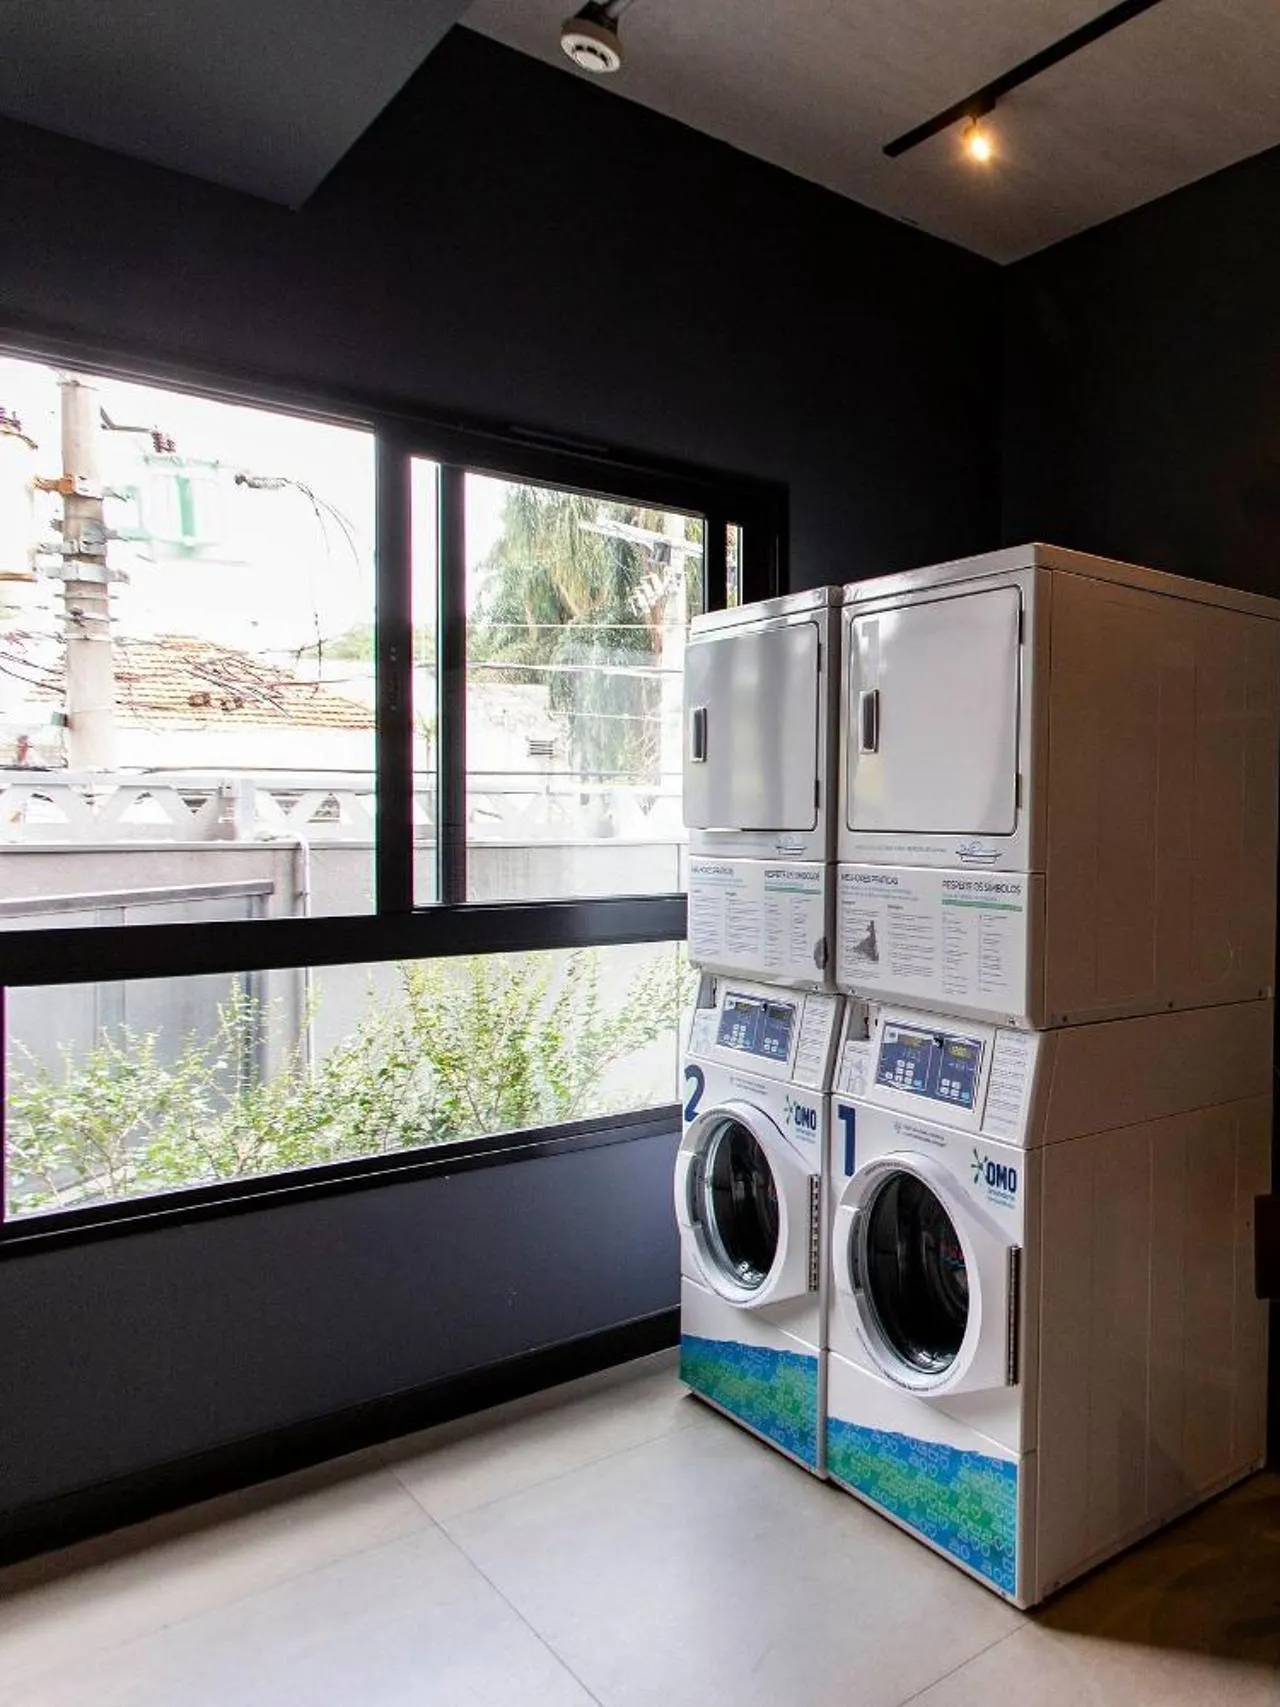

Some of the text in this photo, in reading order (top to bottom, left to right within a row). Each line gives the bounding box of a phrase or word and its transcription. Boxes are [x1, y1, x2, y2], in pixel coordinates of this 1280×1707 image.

[684, 1064, 705, 1122] 2
[795, 1105, 817, 1131] OMO
[837, 1104, 856, 1177] 1
[985, 1161, 1017, 1194] OMO
